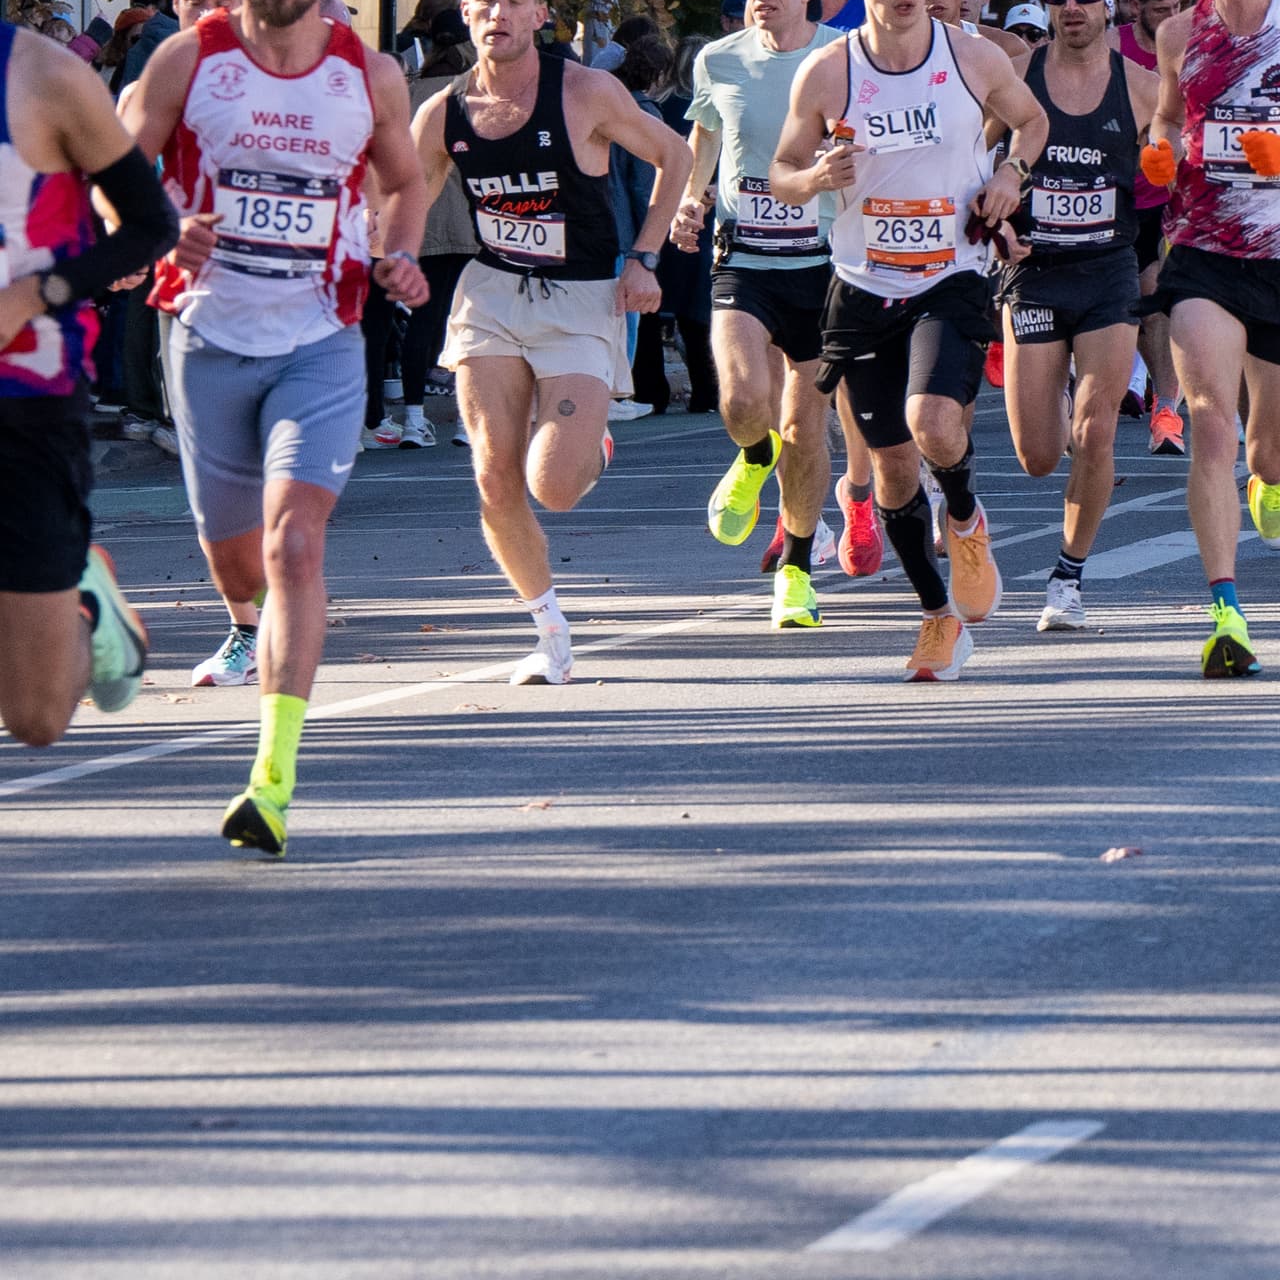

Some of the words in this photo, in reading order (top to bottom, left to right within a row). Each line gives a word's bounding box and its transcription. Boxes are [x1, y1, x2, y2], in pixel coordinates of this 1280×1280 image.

[251, 111, 314, 131] WARE
[868, 107, 936, 137] SLIM
[1214, 107, 1233, 120] tcs
[229, 132, 332, 156] JOGGERS
[1219, 125, 1278, 151] 13
[1046, 145, 1102, 165] FRUGA
[231, 170, 259, 190] tcs
[466, 171, 560, 198] COLLE
[746, 178, 763, 192] tcs
[1042, 175, 1061, 190] tcs
[234, 195, 315, 234] 1855
[750, 196, 804, 220] 1235
[871, 200, 892, 214] tcs
[1046, 194, 1103, 217] 1308
[491, 218, 548, 246] 1270
[875, 218, 943, 243] 2634
[1012, 308, 1054, 328] NACHO
